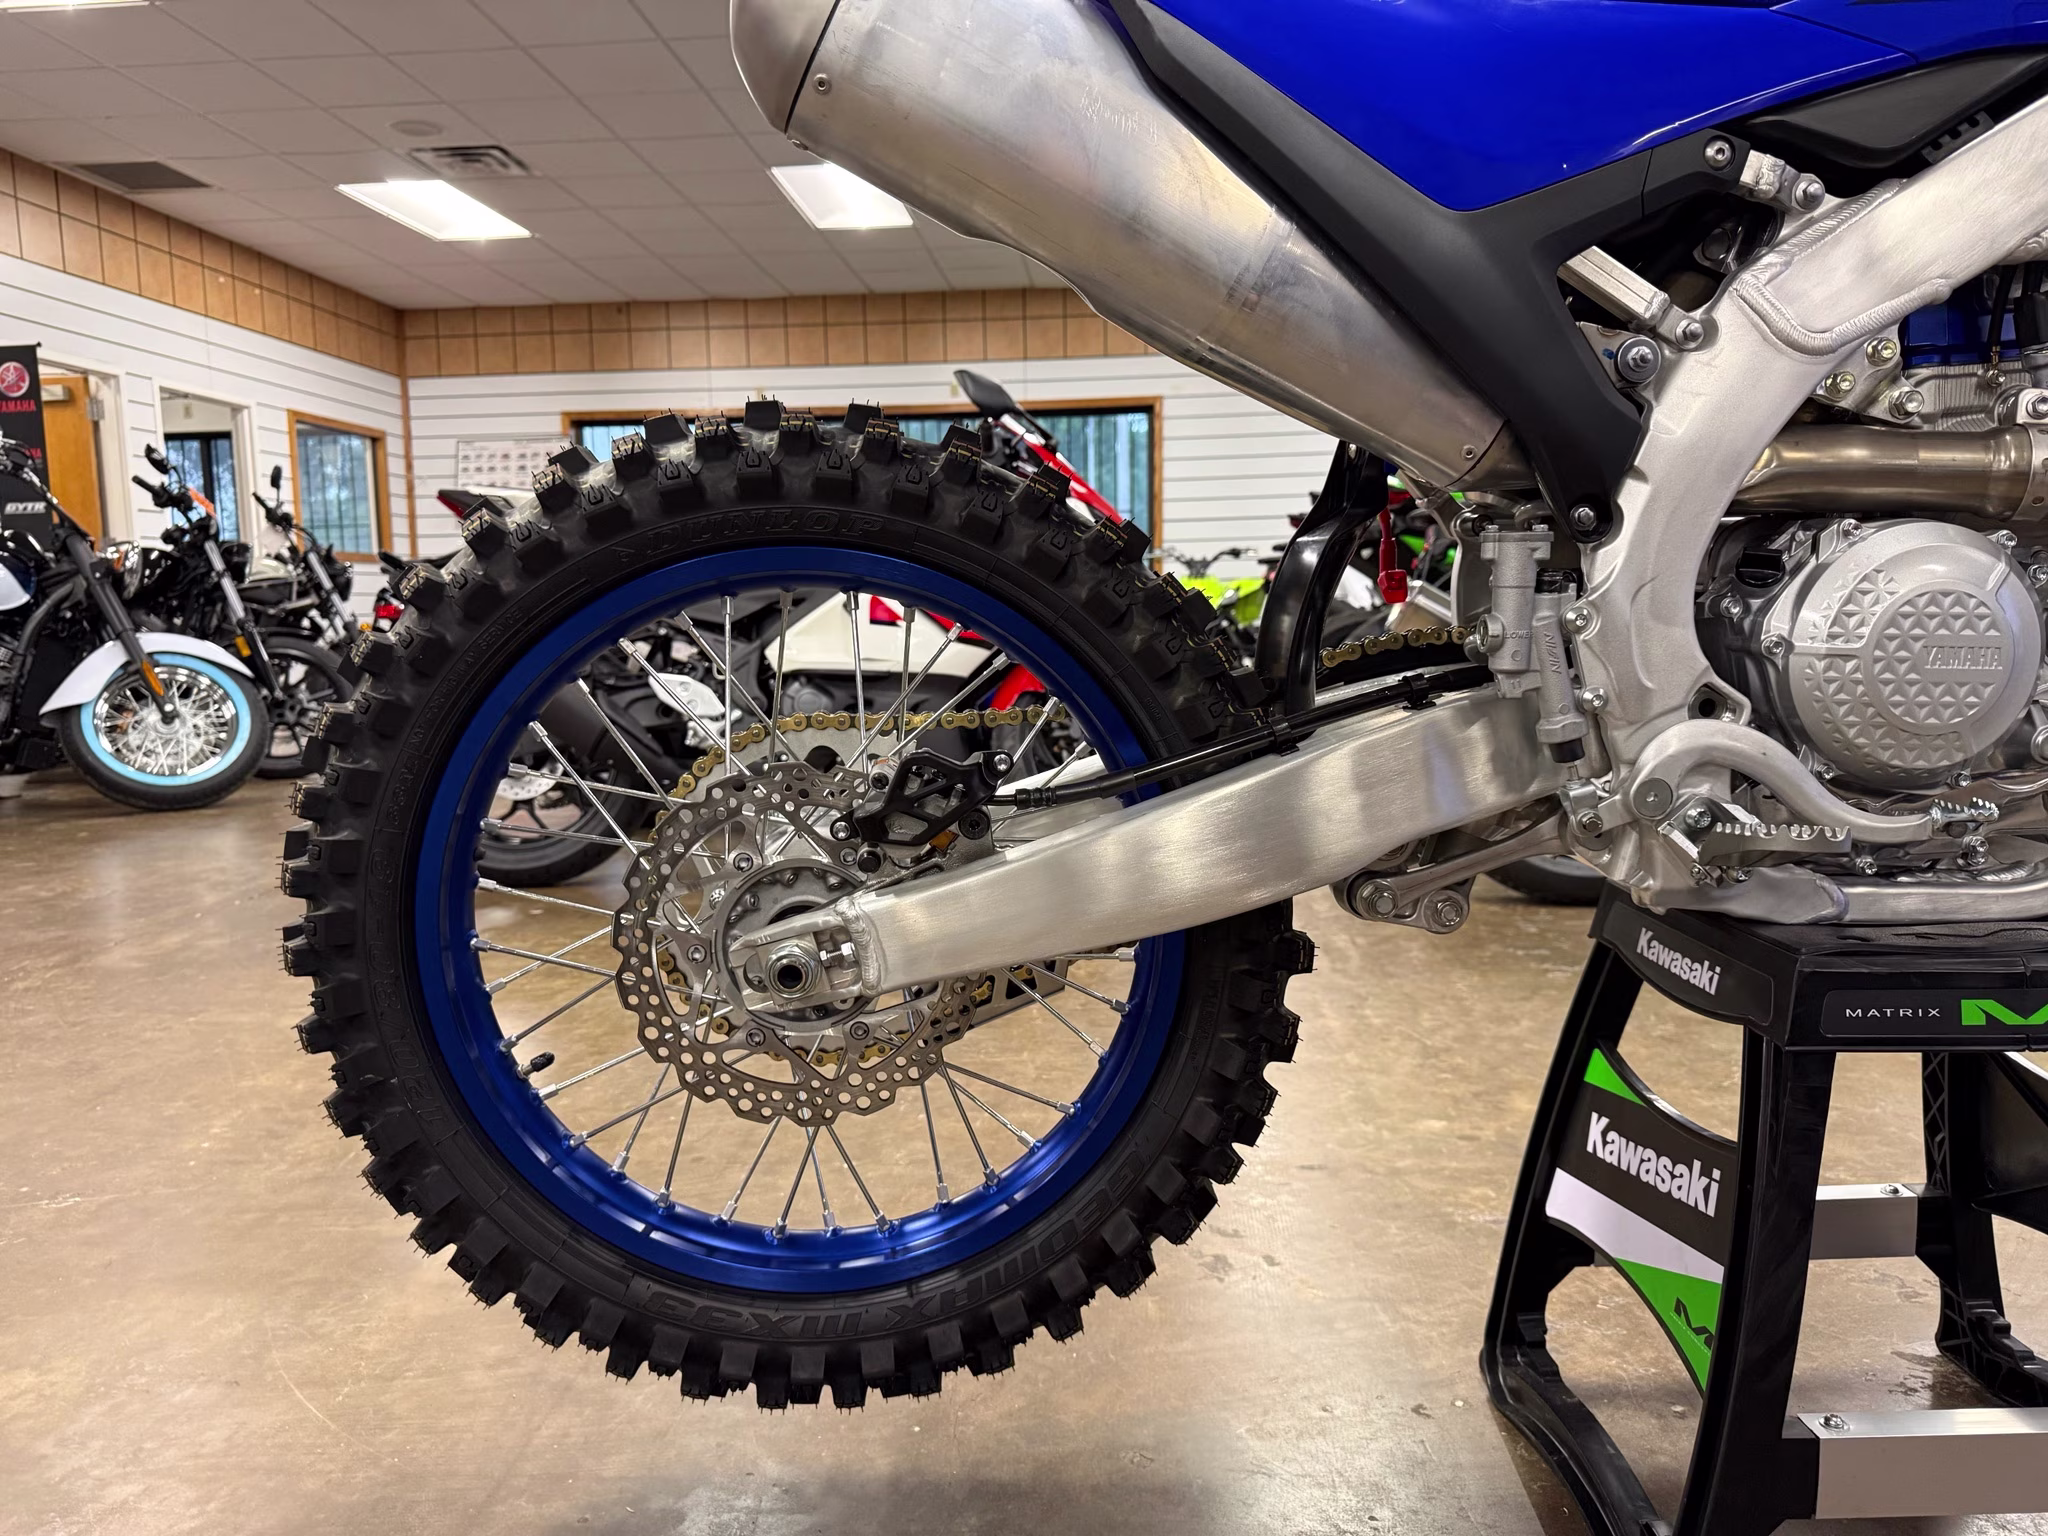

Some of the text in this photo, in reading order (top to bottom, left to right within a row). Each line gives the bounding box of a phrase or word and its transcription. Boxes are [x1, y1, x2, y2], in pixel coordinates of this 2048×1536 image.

[0, 399, 36, 413] AMAHA
[646, 510, 887, 557] DUNLOP
[1923, 646, 2003, 670] YAMAHA
[1636, 927, 1722, 996] Kawasaki
[1845, 1008, 1941, 1018] MATRIX
[1586, 1111, 1721, 1218] Kawasaki
